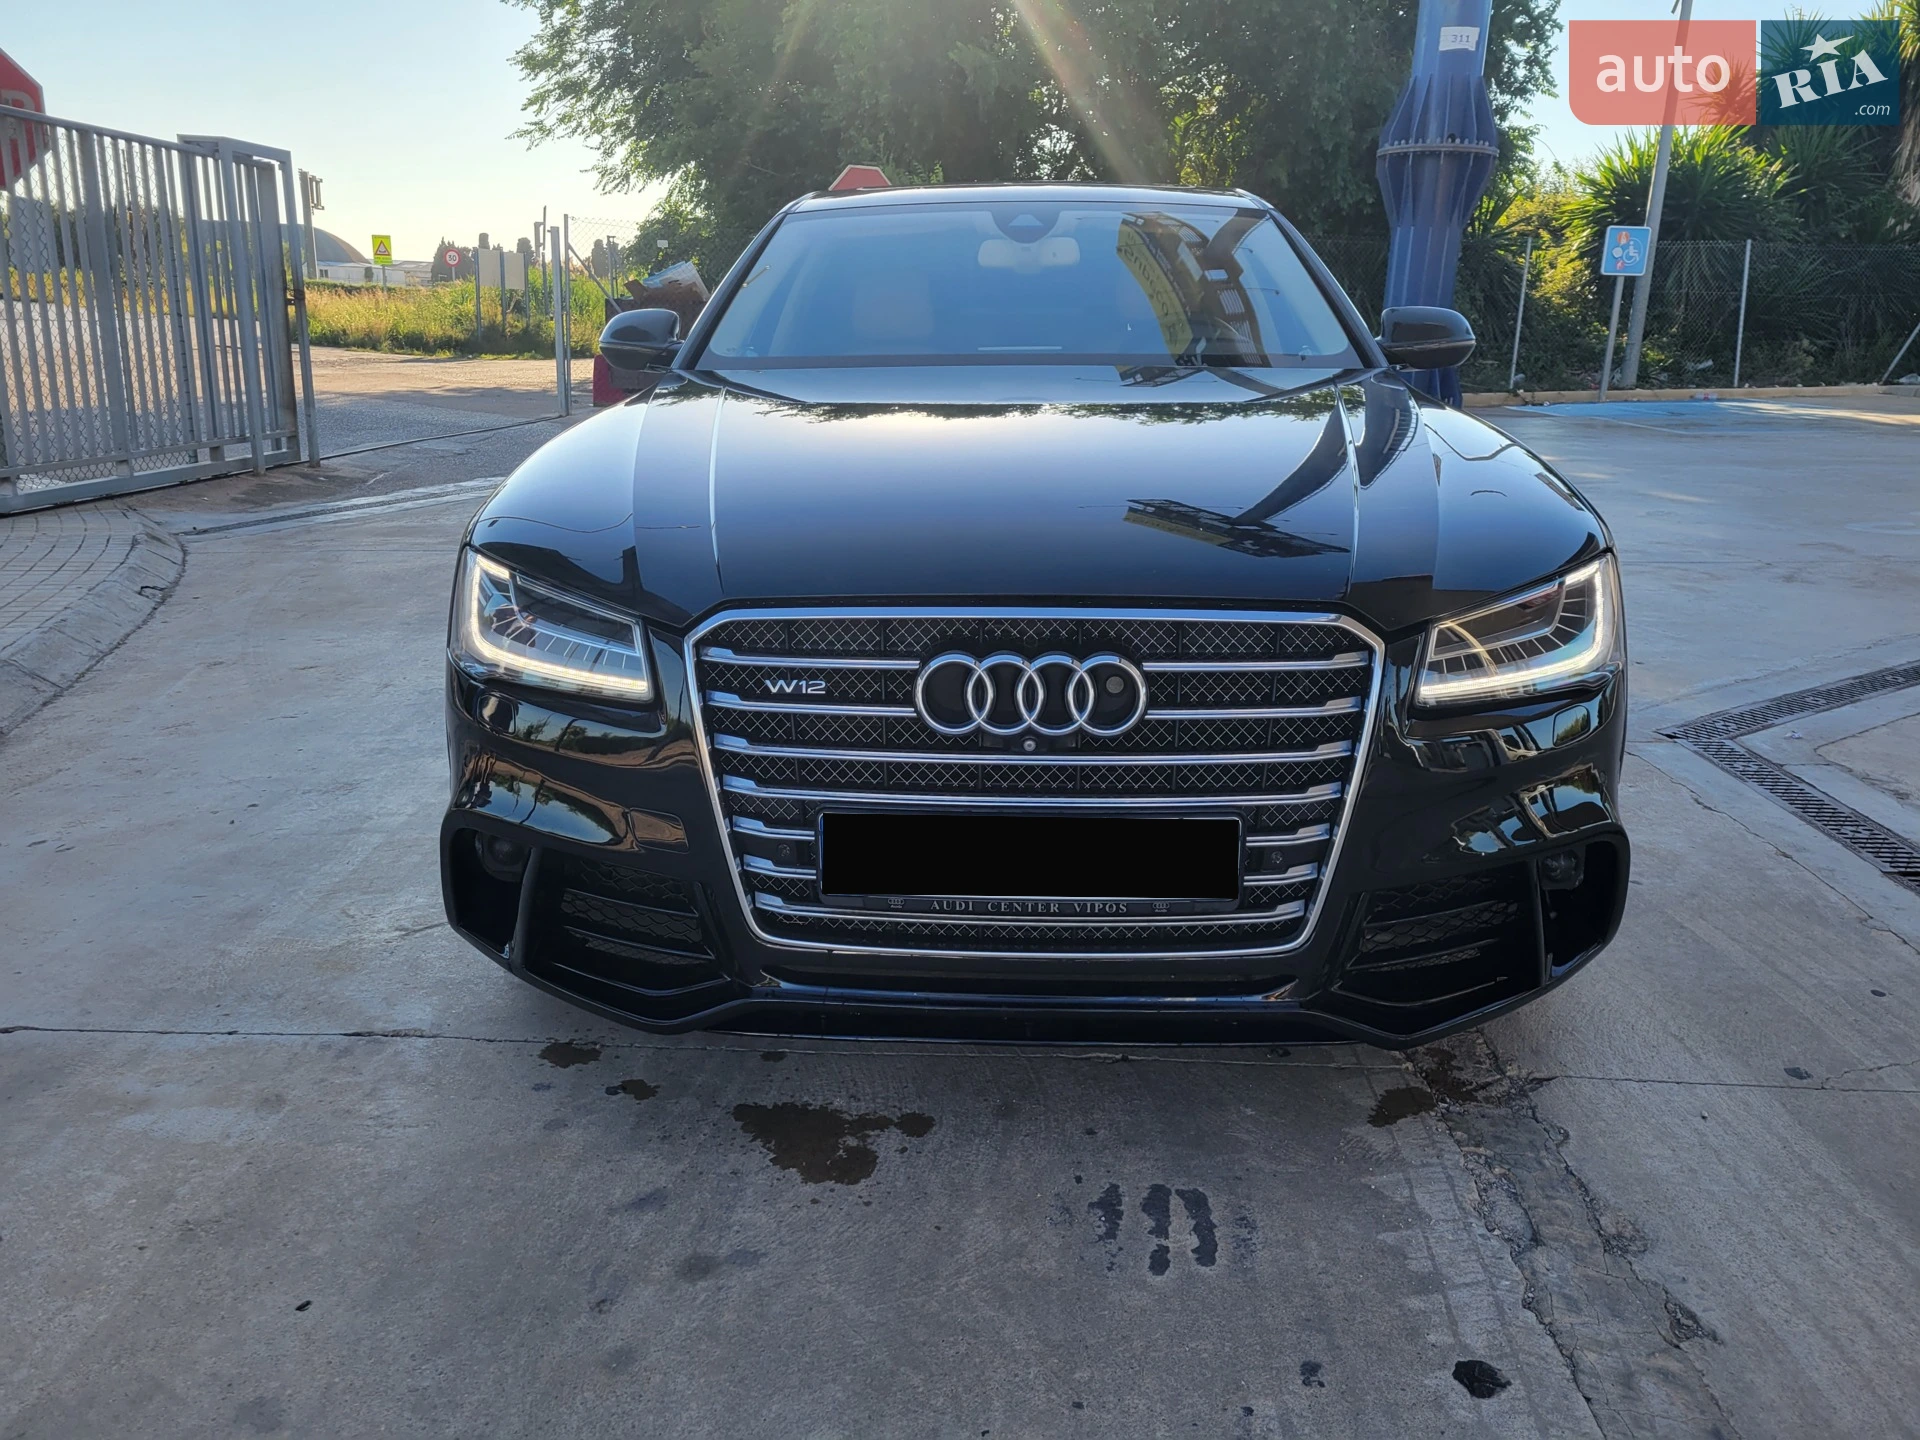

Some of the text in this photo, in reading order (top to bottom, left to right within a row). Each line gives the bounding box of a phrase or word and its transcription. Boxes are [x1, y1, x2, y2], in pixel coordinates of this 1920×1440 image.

[1451, 35, 1470, 43] 311
[764, 679, 826, 694] W12
[930, 900, 1128, 914] AUDI CENTER VIPOS
